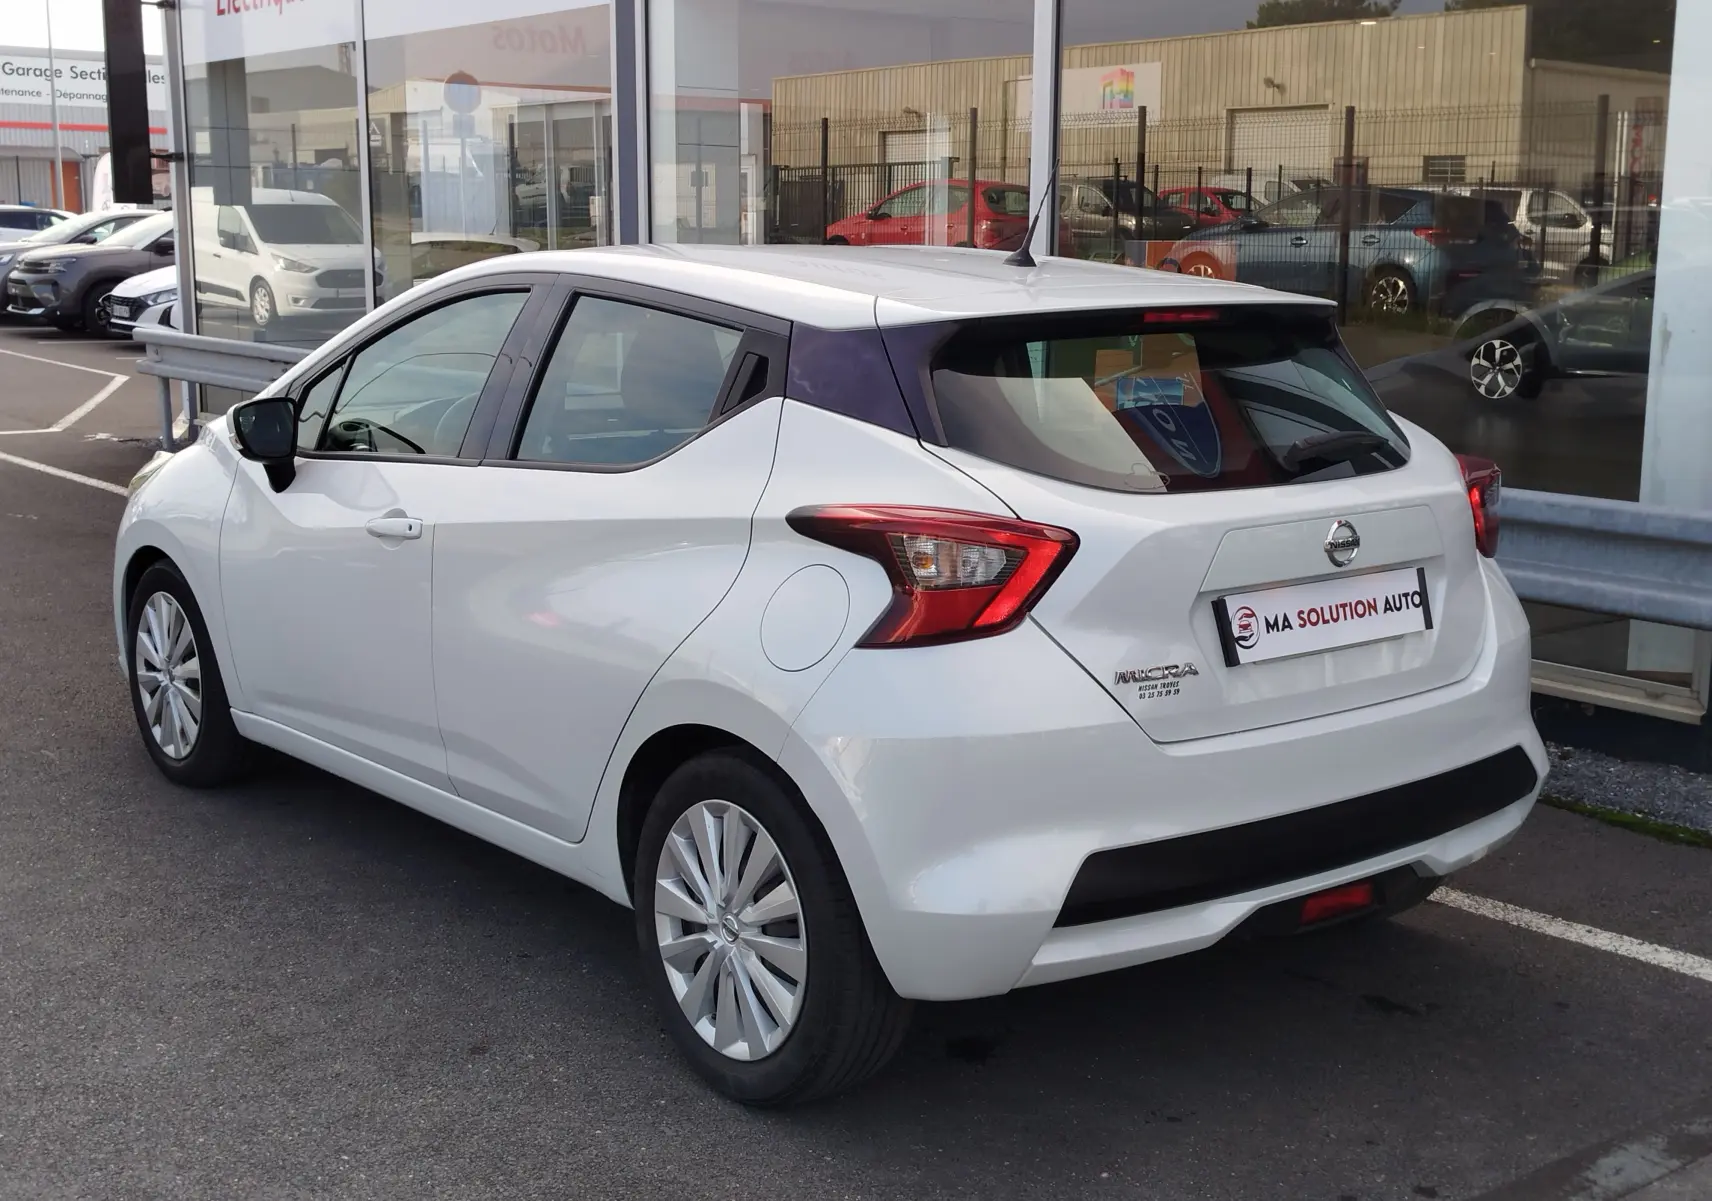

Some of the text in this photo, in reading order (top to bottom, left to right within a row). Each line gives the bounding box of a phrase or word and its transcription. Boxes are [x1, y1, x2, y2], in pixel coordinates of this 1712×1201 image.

[2, 61, 63, 81] Garage
[0, 88, 42, 98] tenance
[55, 89, 108, 102] Dépannag
[1264, 590, 1422, 634] MA SOLUTION AUTO
[1114, 662, 1199, 685] MICRA
[1138, 680, 1180, 692] NISSAN TROYES
[1147, 691, 1155, 699] 25
